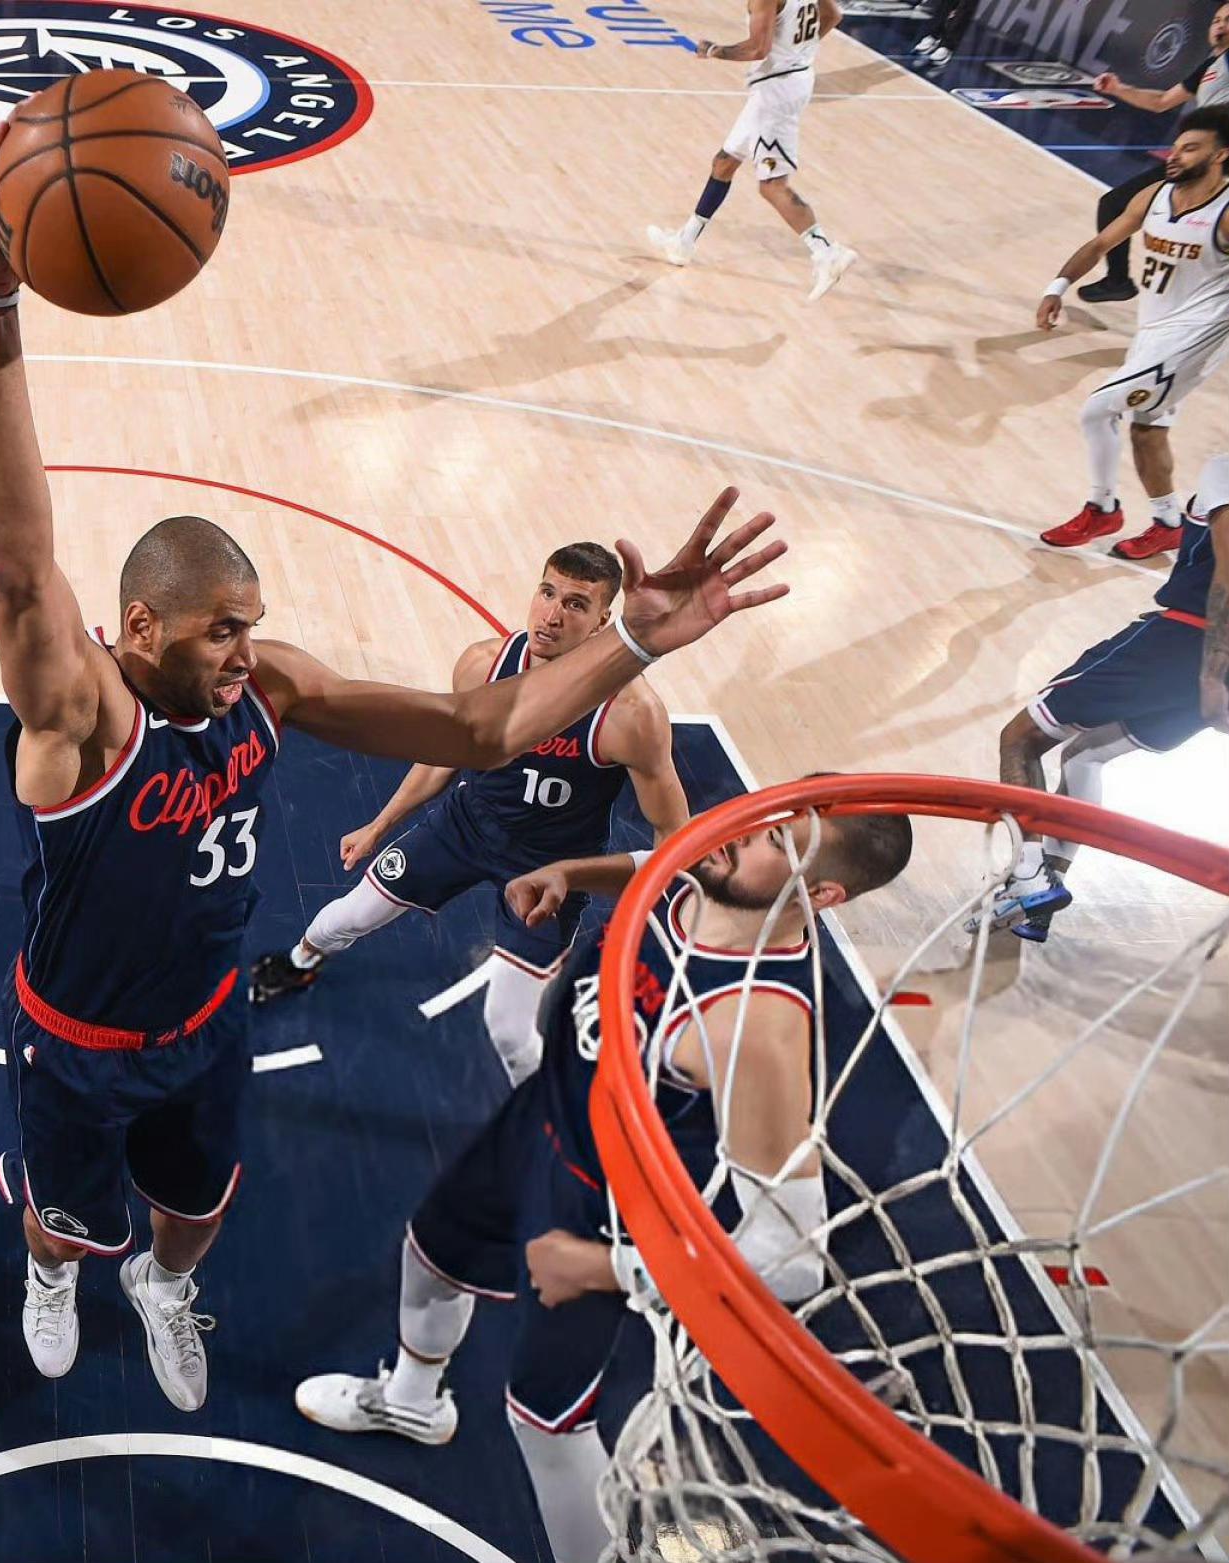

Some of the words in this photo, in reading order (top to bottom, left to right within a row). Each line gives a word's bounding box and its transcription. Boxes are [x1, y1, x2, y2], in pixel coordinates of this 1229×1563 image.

[108, 9, 245, 41] LOS
[793, 3, 818, 45] 32
[1141, 256, 1176, 295] 27
[128, 729, 267, 836] Clippers
[522, 767, 573, 808] 10
[189, 805, 260, 888] 33
